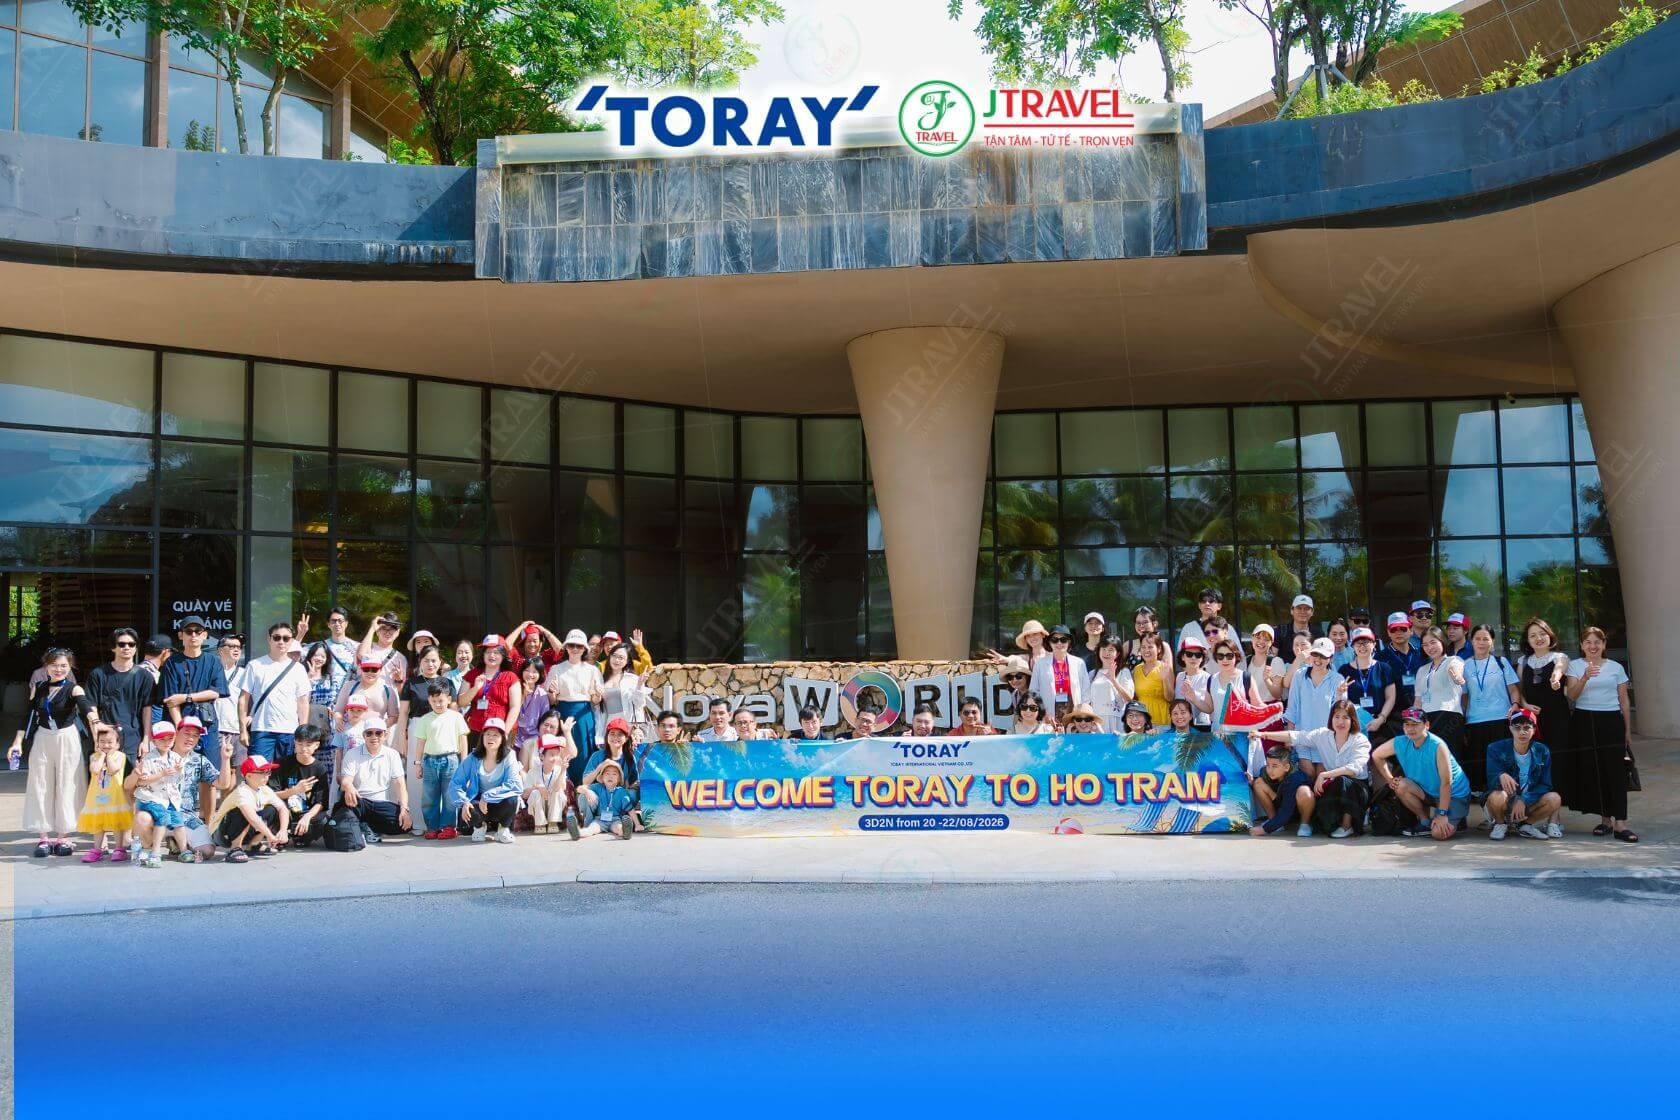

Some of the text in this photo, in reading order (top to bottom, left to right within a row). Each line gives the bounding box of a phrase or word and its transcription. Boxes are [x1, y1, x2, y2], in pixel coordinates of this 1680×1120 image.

[172, 598, 233, 613] QUÀY VÉ
[173, 616, 233, 630] KÁNG
[664, 770, 1222, 811] WELCOME TORAY TO HO TRAM
[864, 818, 894, 828] 3D2N
[895, 817, 921, 828] from
[922, 818, 936, 828] 20
